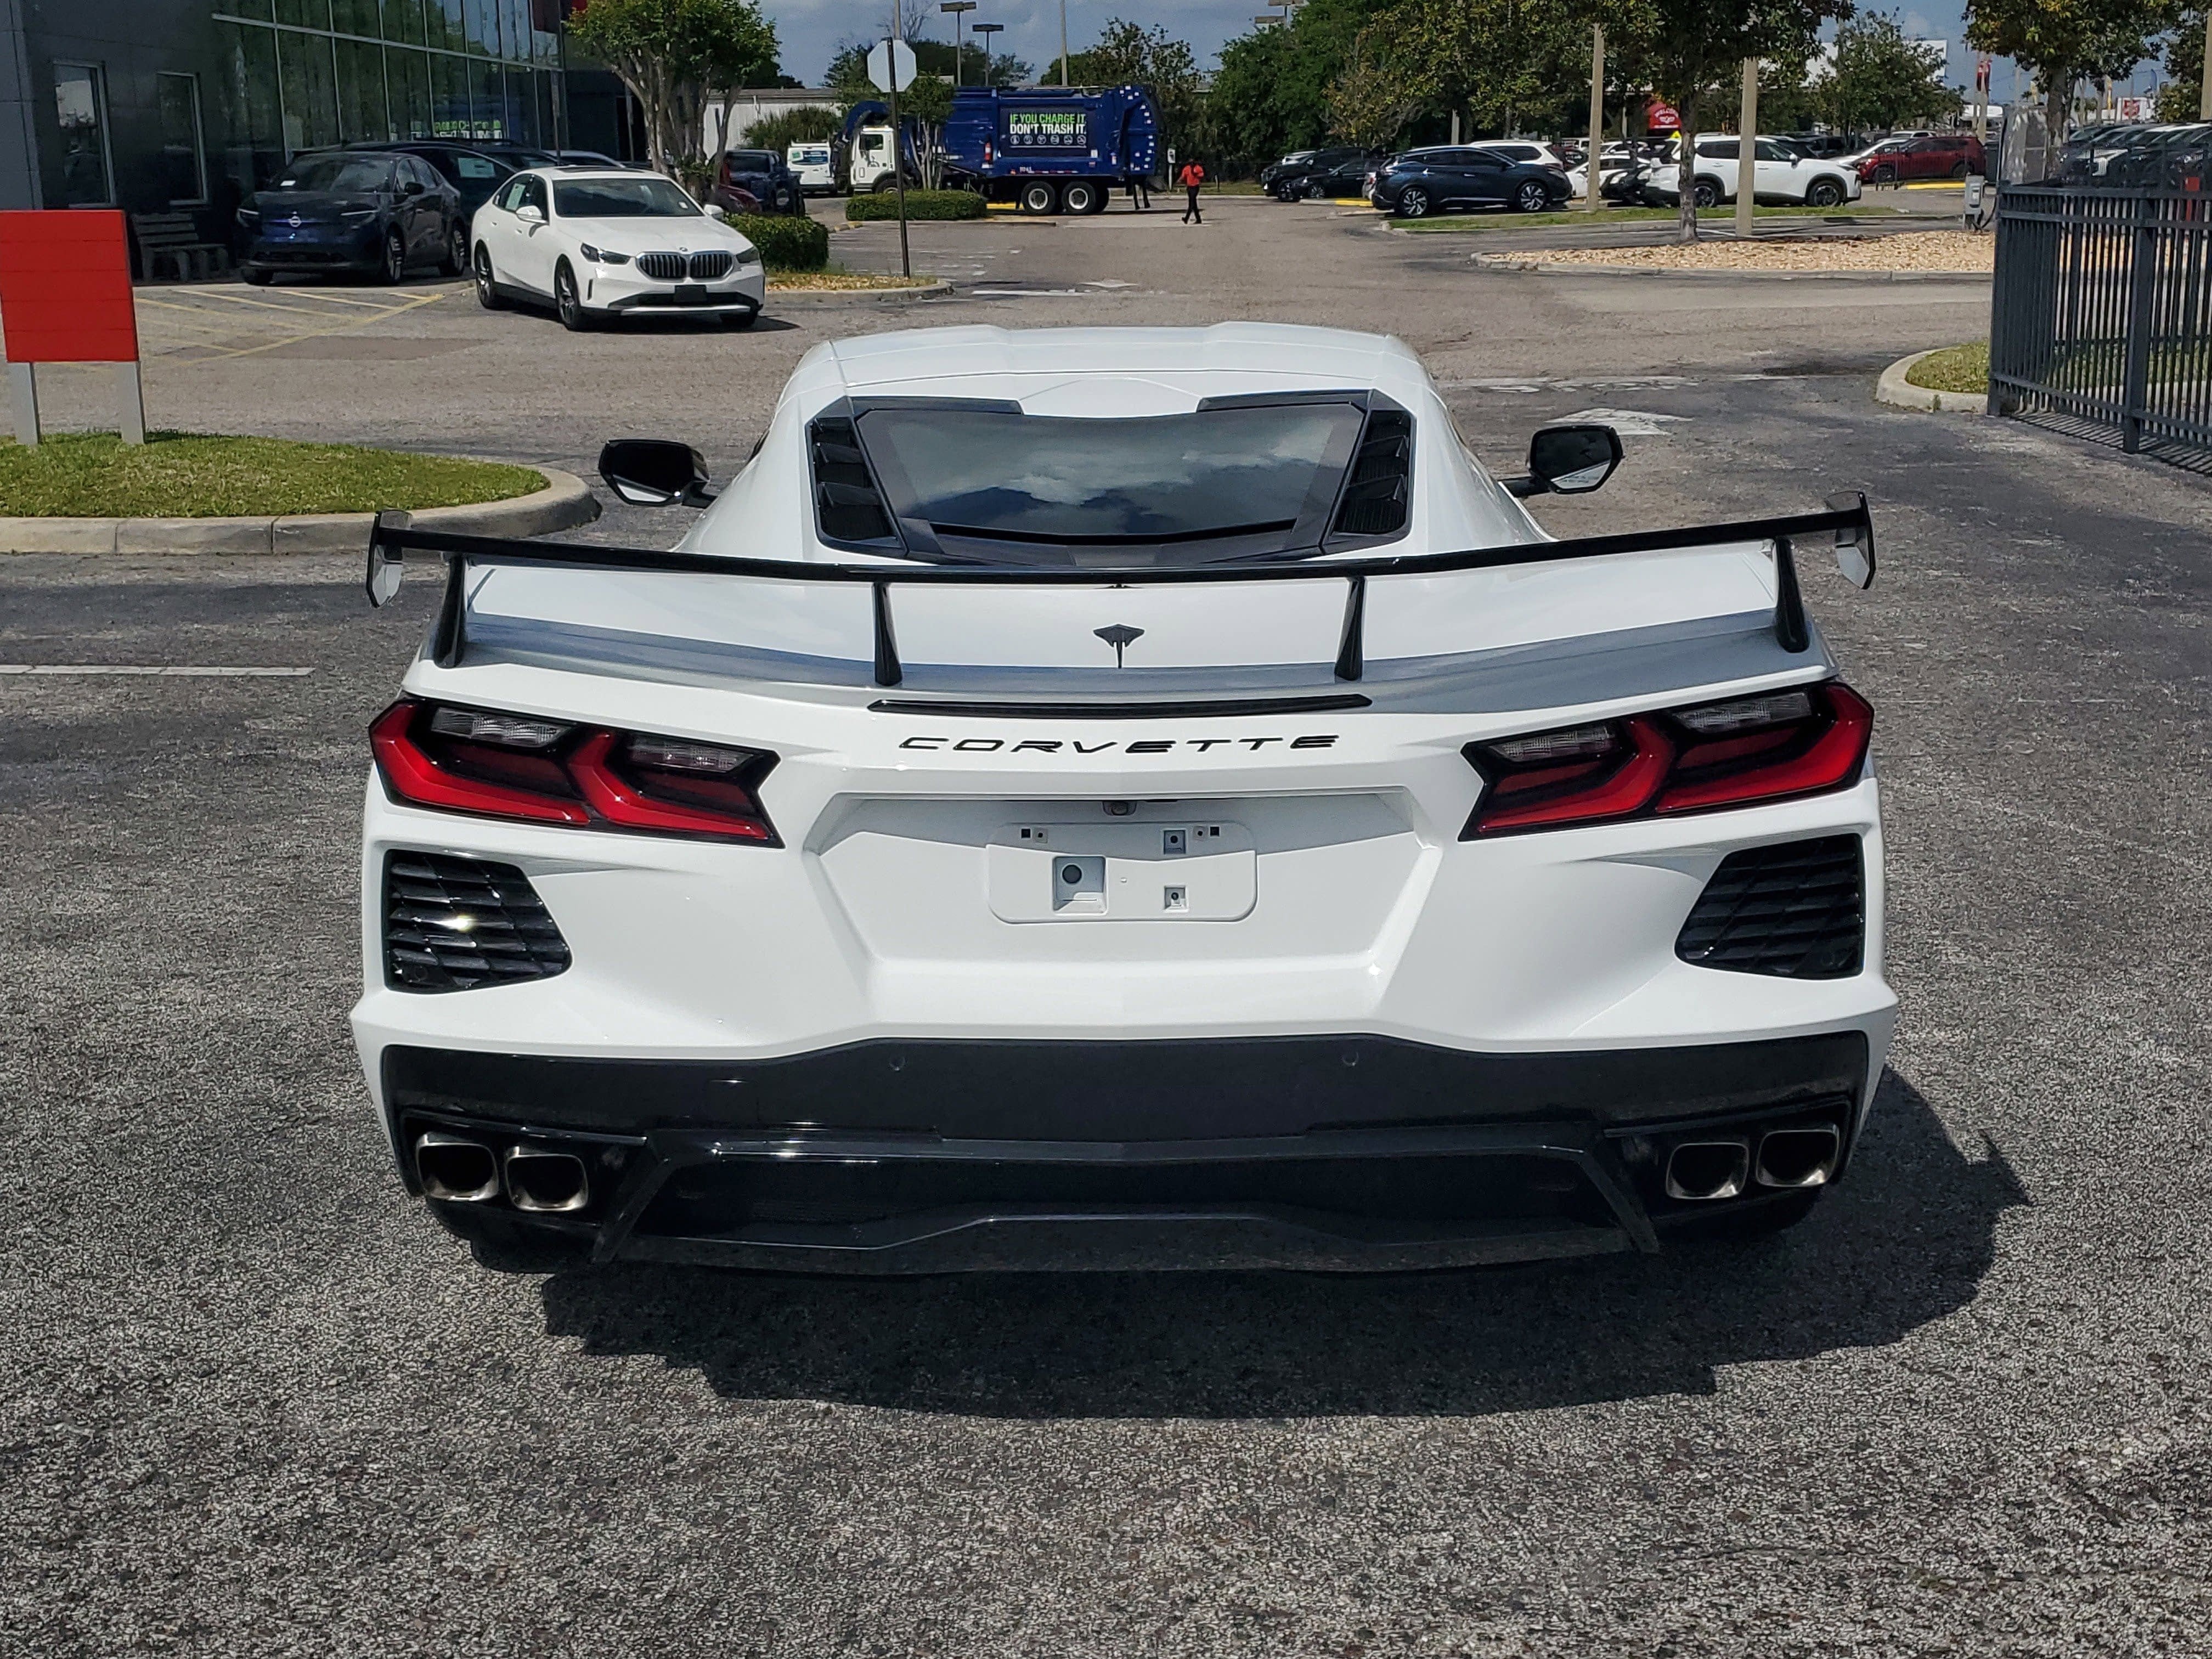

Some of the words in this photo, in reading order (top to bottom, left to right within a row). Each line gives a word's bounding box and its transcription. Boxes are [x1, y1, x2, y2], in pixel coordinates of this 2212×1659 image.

[1010, 114, 1018, 123] IF
[1020, 114, 1037, 123] YOU
[1039, 114, 1075, 123] CHARGE
[1009, 123, 1039, 134] DON'T
[1041, 123, 1074, 134] TRASH
[898, 735, 1340, 754] CORVETTE
